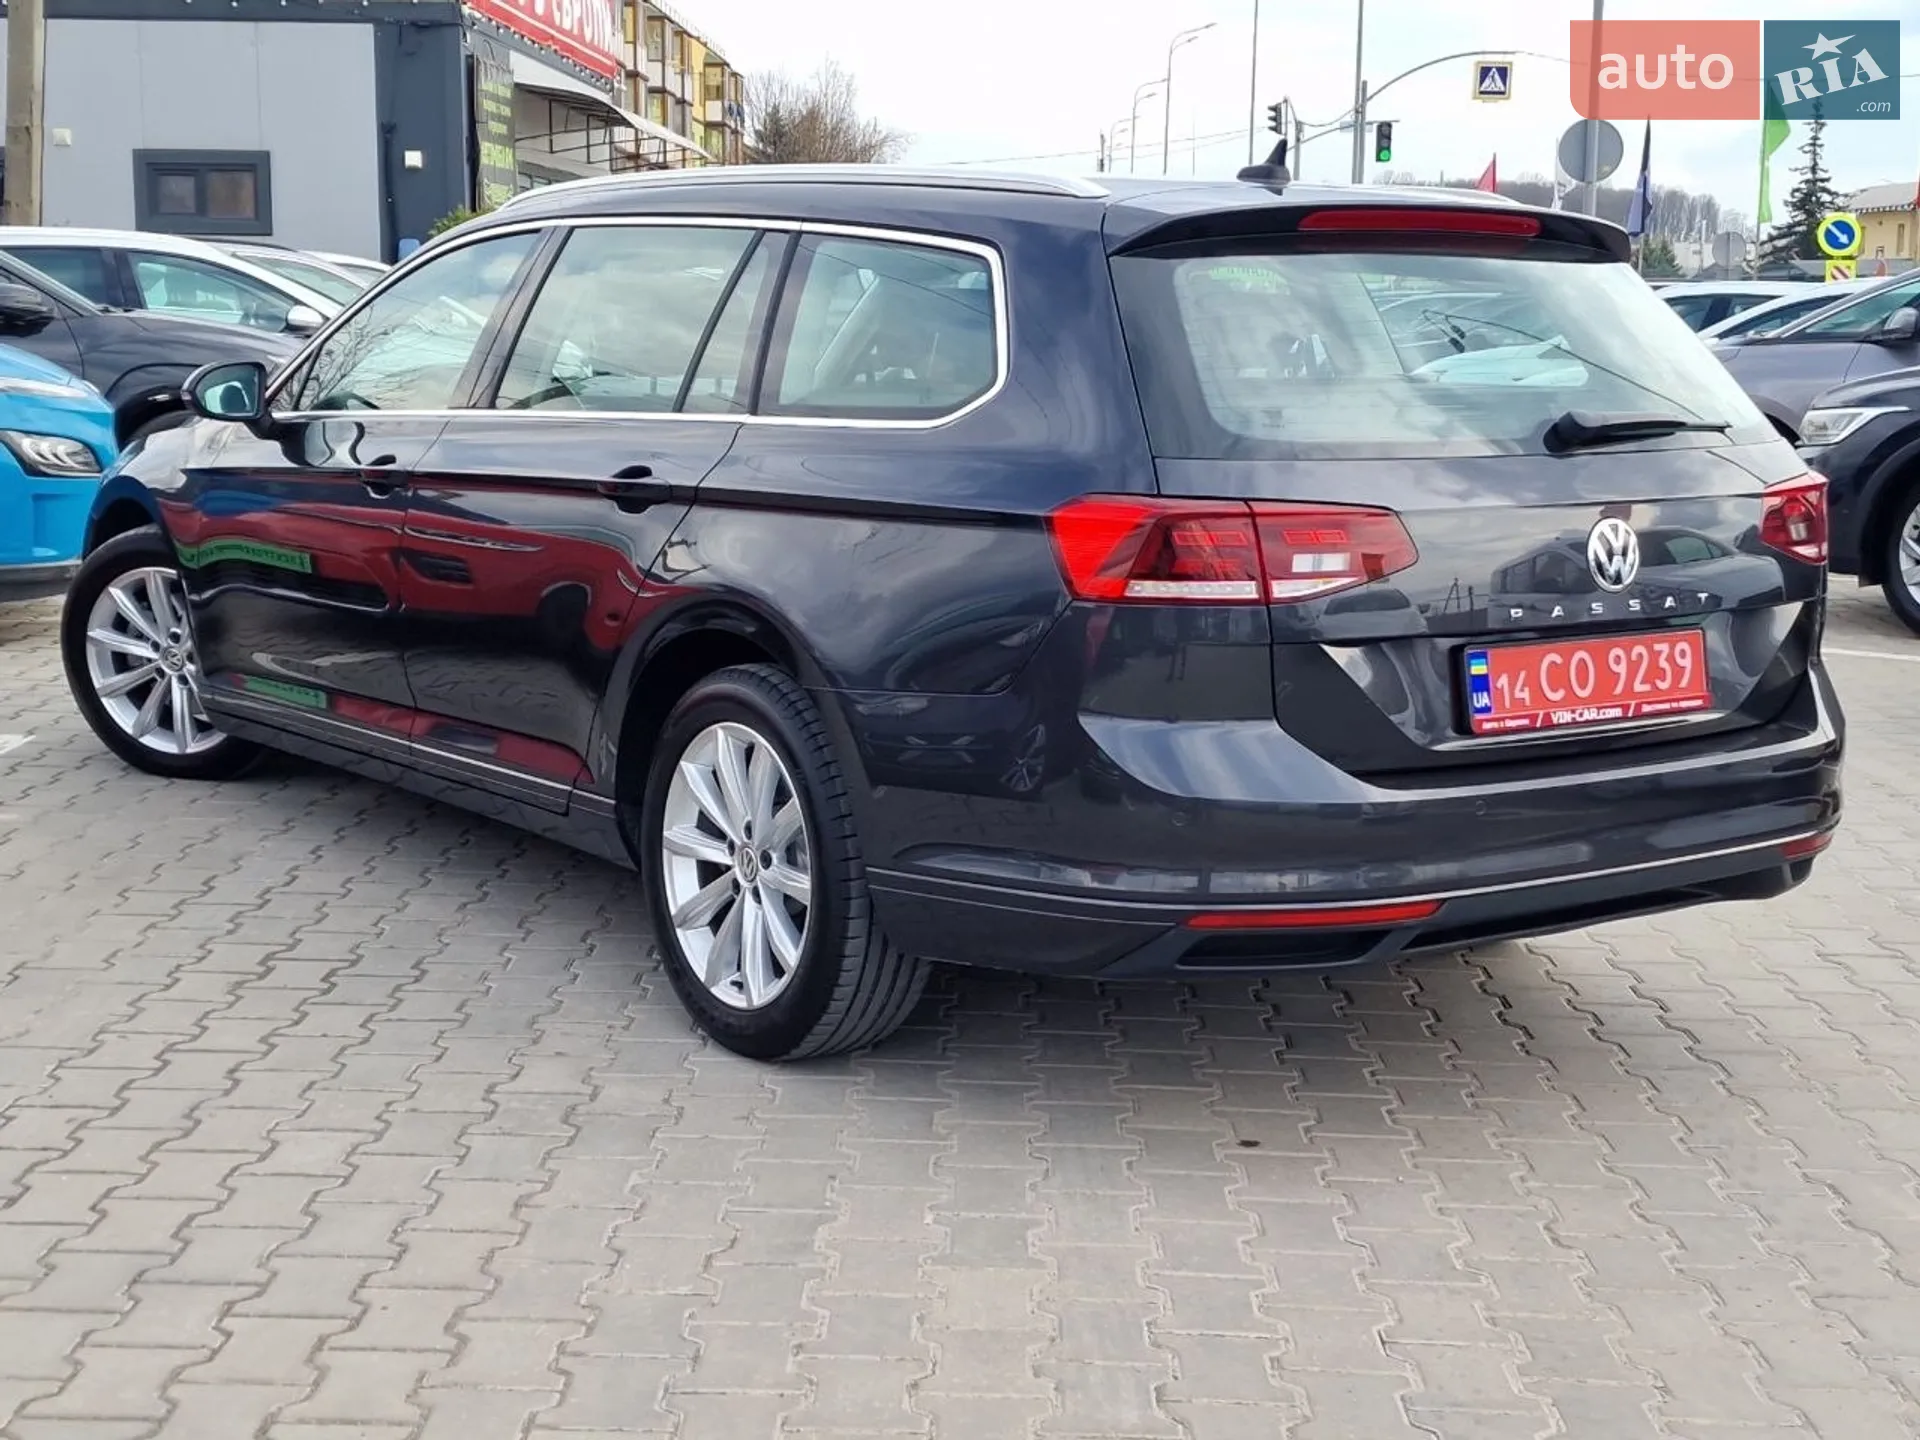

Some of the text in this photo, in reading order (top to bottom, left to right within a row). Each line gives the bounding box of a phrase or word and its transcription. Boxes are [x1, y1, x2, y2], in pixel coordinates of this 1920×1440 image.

[1510, 592, 1708, 621] PASSAT
[1496, 641, 1692, 709] 14 CO 9239
[1473, 691, 1491, 708] UA
